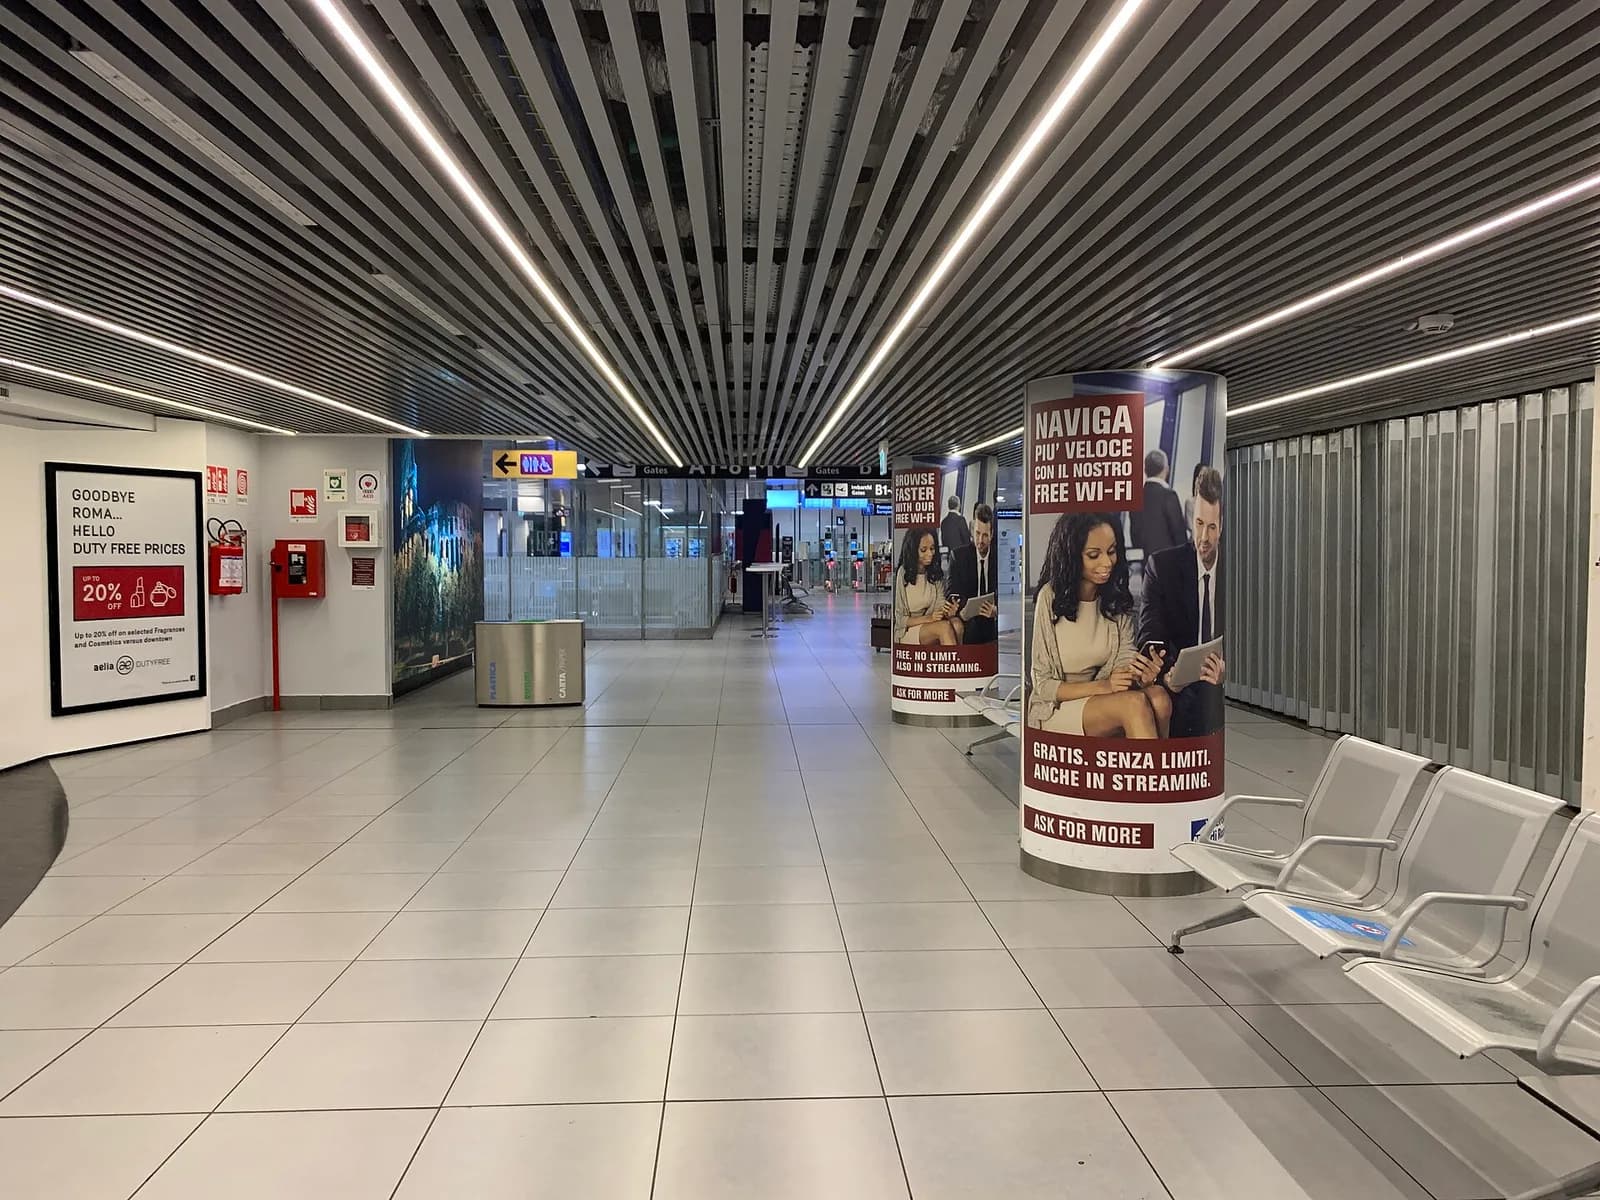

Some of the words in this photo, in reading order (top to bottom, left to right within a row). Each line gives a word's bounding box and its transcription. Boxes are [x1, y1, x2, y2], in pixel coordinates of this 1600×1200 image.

[1036, 405, 1133, 440] NAVIGA
[1035, 443, 1060, 462] PIU'
[1065, 438, 1132, 460] VELOCE
[644, 466, 668, 475] Gates
[816, 466, 840, 475] Gates
[1034, 464, 1054, 481] CON
[1058, 464, 1068, 478] IL
[1073, 461, 1132, 478] NOSTRO
[896, 472, 935, 486] BROWSE
[72, 489, 136, 503] GOODBYE
[896, 487, 934, 502] FASTER
[1034, 482, 1069, 504] FREE
[1075, 480, 1132, 502] WI-FI
[72, 506, 123, 519] ROMA...
[896, 502, 912, 513] WITH
[915, 502, 934, 512] OUR
[896, 514, 909, 524] FREE
[910, 512, 935, 523] WI-FI
[73, 525, 115, 537] HELLO
[73, 543, 107, 554] DUTY
[111, 543, 141, 554] FREE
[145, 543, 186, 554] PRICES
[83, 583, 122, 602] 20%
[74, 632, 84, 640] Up
[144, 635, 173, 643] downtown
[896, 649, 912, 660] FREE.
[914, 651, 926, 661] NO
[930, 651, 960, 661] LIMIT.
[93, 662, 114, 672] aelia
[896, 661, 912, 672] ALSO
[914, 662, 923, 672] IN
[926, 662, 982, 673] STREAMING.
[896, 687, 907, 698] ASK
[908, 689, 921, 699] FOR
[924, 690, 949, 700] MORE
[1033, 741, 1089, 766] GRATIS.
[1096, 750, 1154, 769] SENZA
[1161, 749, 1211, 769] LIMITI.
[1033, 763, 1080, 787] ANCHE
[1086, 772, 1105, 790] IN
[1112, 771, 1211, 792] STREAMING.
[1034, 813, 1055, 834] ASK
[1058, 820, 1086, 841] FOR
[1092, 825, 1141, 845] MORE
